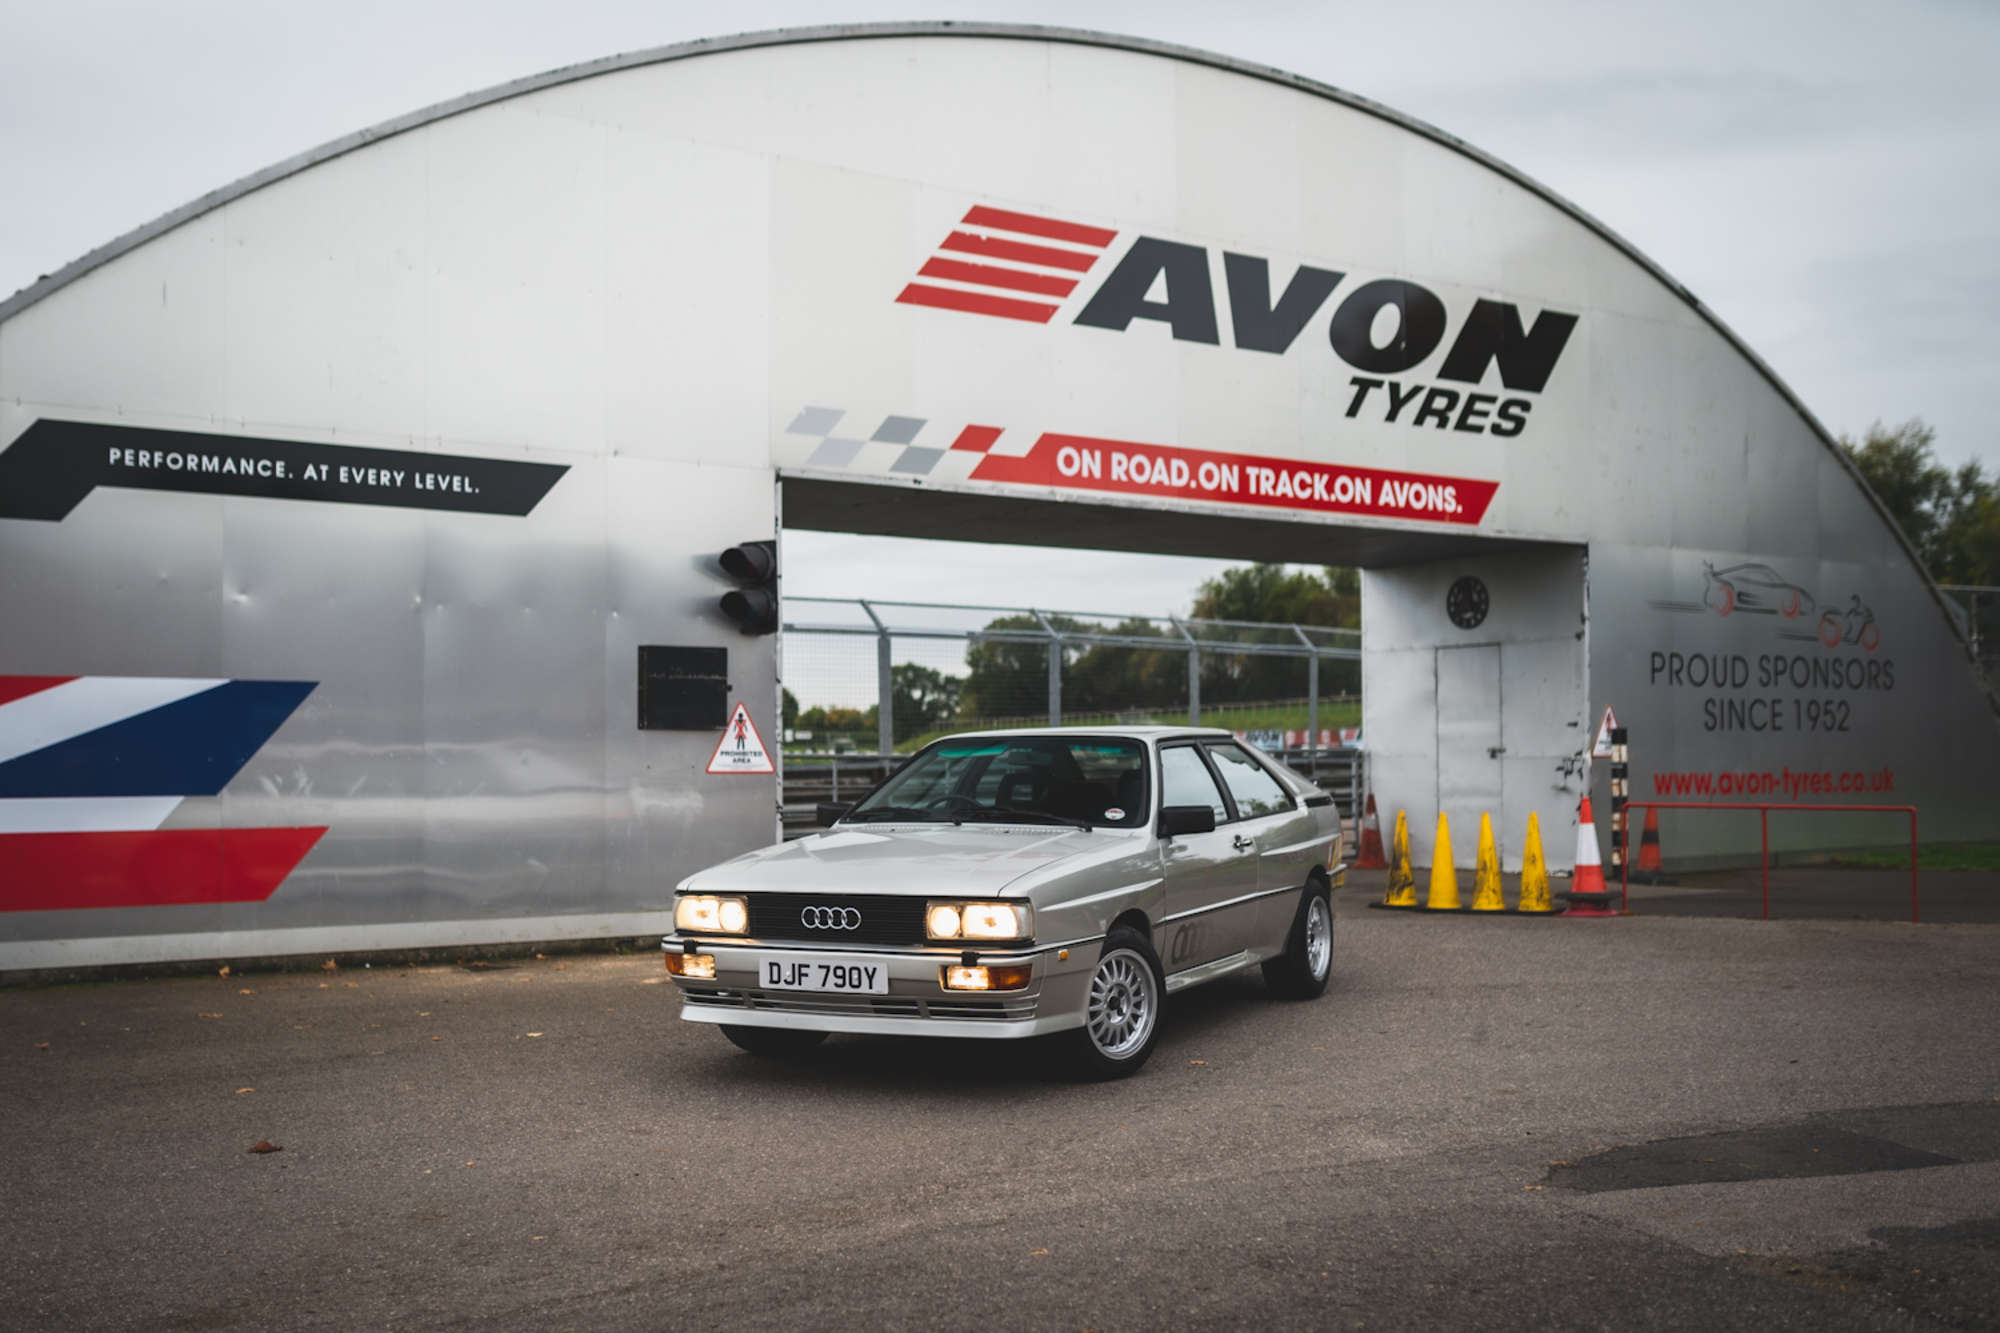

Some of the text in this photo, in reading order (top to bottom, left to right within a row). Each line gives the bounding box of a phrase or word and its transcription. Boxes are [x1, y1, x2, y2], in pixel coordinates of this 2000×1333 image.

[1072, 235, 1579, 394] AVON
[1345, 375, 1532, 438] TYRES
[109, 447, 480, 493] PERFORMANCE. AT EVERY LEVEL.
[1056, 446, 1102, 480] ON
[1378, 479, 1463, 514] AVONS.
[1651, 651, 1896, 691] PROUD SPONSORS
[1704, 698, 1851, 731] SINCE 1952
[1653, 765, 1896, 800] www.avon-tyres.co.uk
[768, 962, 877, 990] DJF 790Y
